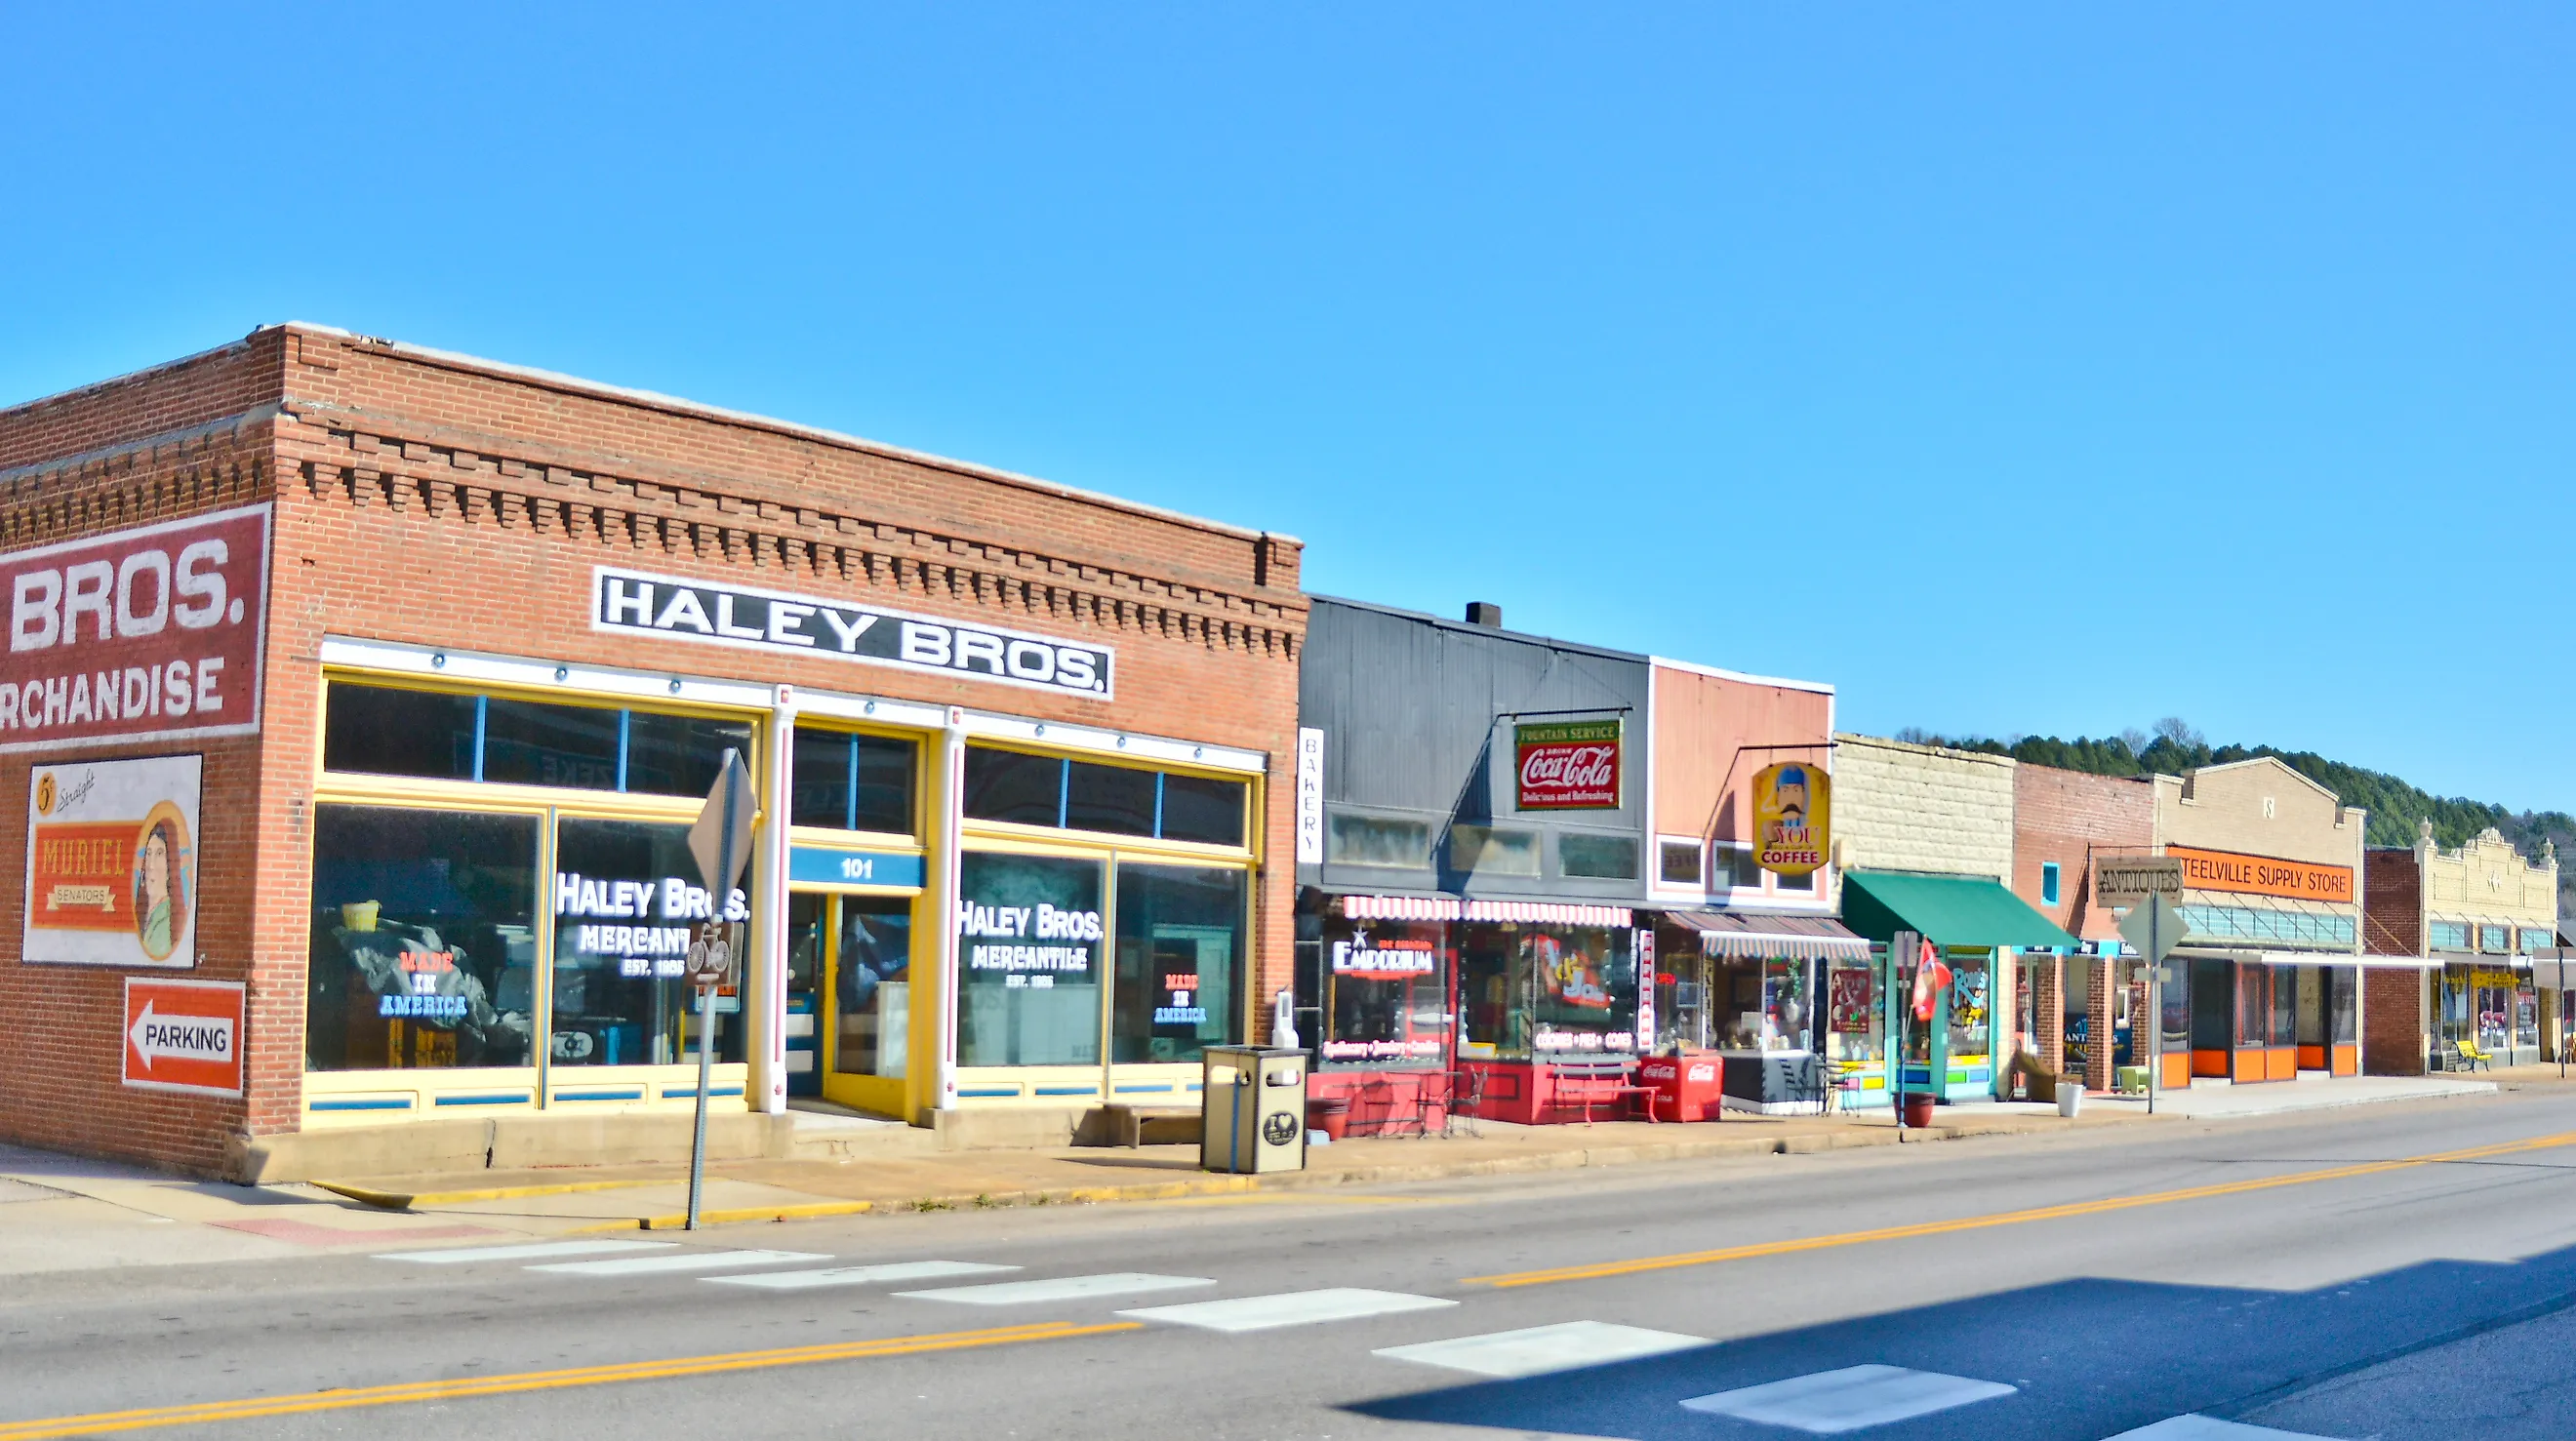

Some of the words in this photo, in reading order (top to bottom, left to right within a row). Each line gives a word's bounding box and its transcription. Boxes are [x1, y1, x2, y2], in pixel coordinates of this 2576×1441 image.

[11, 539, 244, 653] BROS.
[607, 579, 878, 652] HALEY
[901, 621, 1105, 692] BROS.
[1570, 726, 1615, 740] SERVICE
[1521, 745, 1616, 788] Coca-Cola
[57, 768, 96, 813] Straight
[1305, 738, 1317, 850] BAKERY
[1522, 791, 1556, 802] Delicious
[1557, 791, 1571, 802] and
[1572, 789, 1614, 803] Refreshing
[1775, 826, 1821, 845] YOU
[43, 838, 126, 876] MURIEL
[841, 857, 873, 879] 101
[1760, 850, 1818, 864] COFFEE
[2098, 867, 2180, 894] ANTIQUES
[2182, 858, 2251, 884] TEELVILLE
[2258, 865, 2303, 889] SUPPLY
[2308, 872, 2346, 893] STORE
[57, 889, 105, 902] SENATORS
[555, 872, 656, 918] HALEY
[959, 900, 1030, 938] HALEY
[1035, 902, 1104, 941] BROS.
[399, 951, 453, 973] MADE
[623, 959, 652, 977] EST.
[971, 944, 1088, 972] MERCANTILE
[1333, 941, 1433, 971] EMPORIUM
[414, 974, 437, 993] IN
[1165, 974, 1198, 990] MADE
[380, 995, 468, 1016] AMERICA
[1173, 990, 1189, 1007] IN
[1153, 1007, 1207, 1023] AMERICA
[145, 1023, 226, 1053] PARKING
